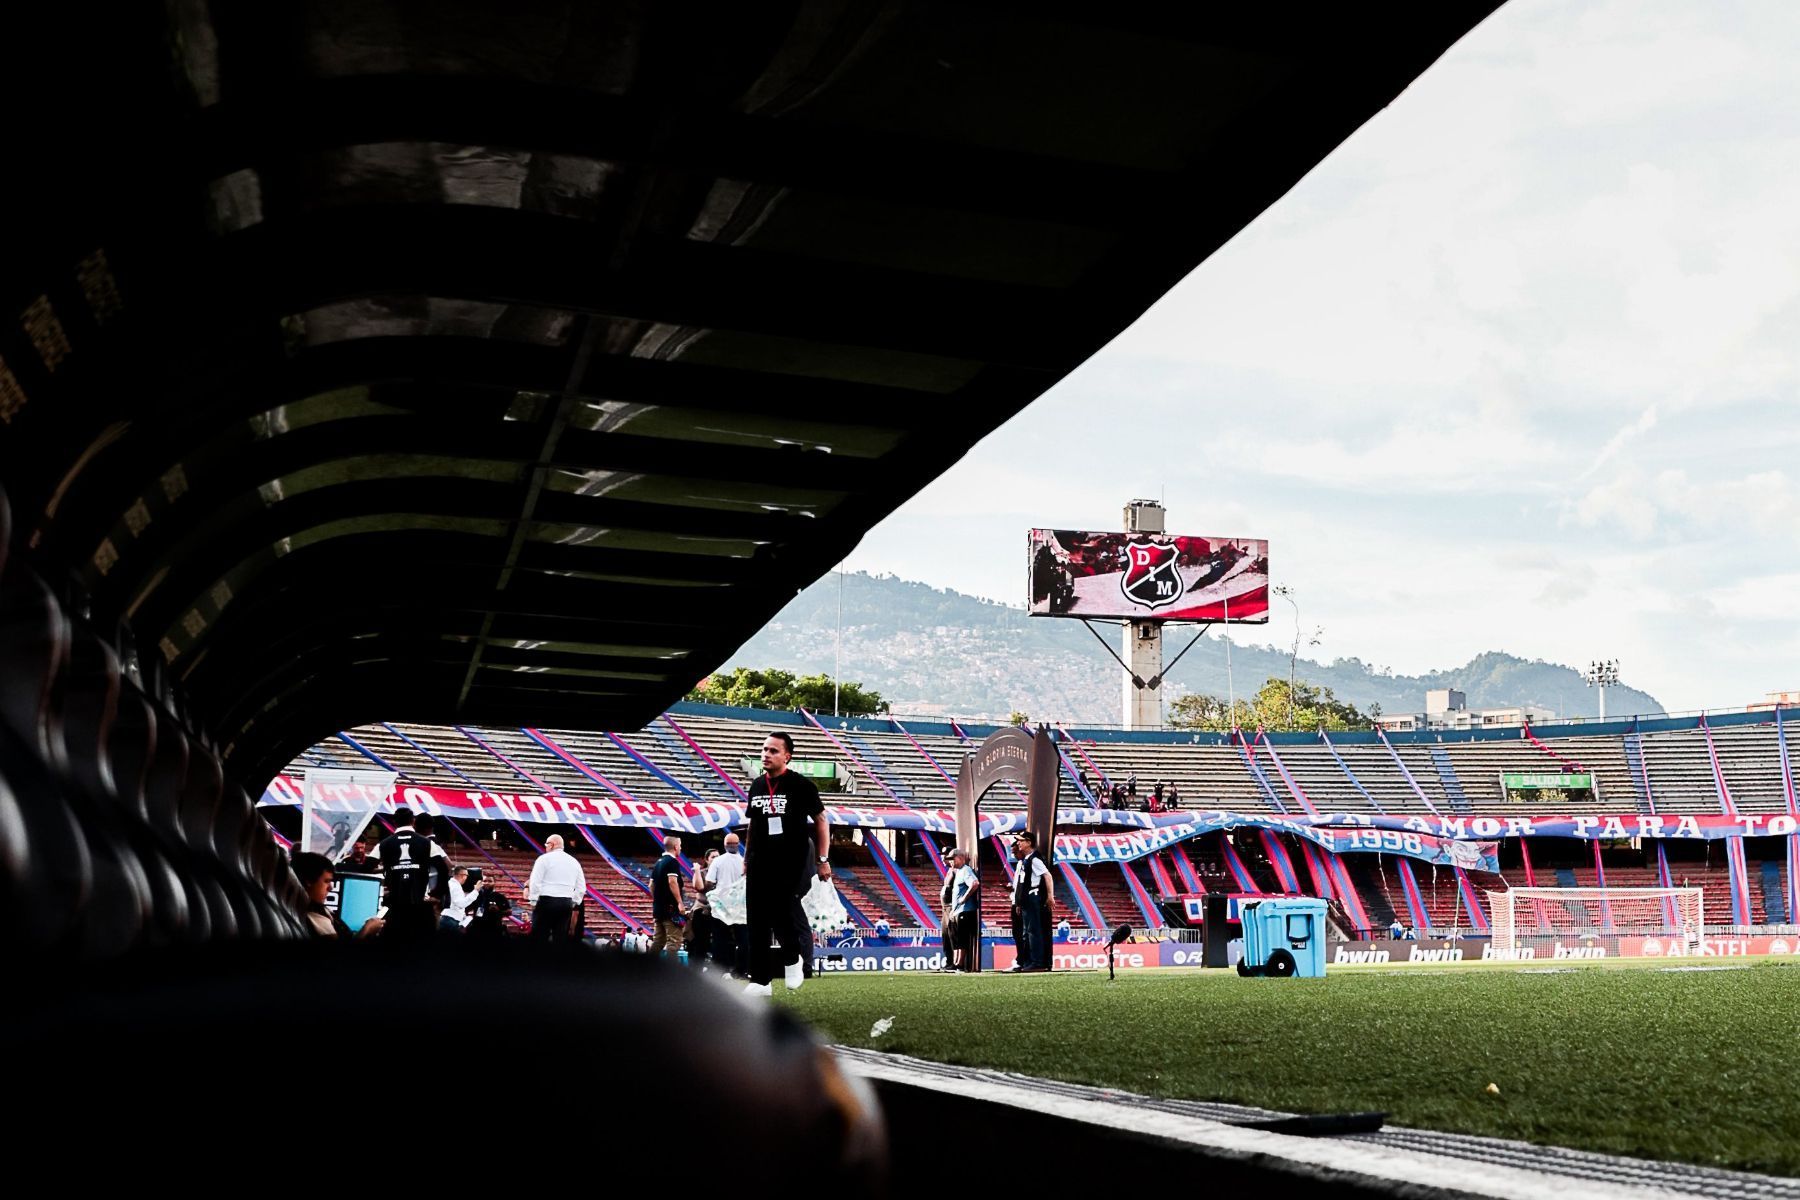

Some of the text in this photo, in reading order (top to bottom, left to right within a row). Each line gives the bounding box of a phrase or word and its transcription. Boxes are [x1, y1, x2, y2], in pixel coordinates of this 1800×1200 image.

[986, 746, 1005, 766] GLORIA
[1007, 745, 1027, 763] ETERNA
[1523, 775, 1560, 785] SALIDA
[751, 798, 787, 808] POWER
[1404, 816, 1537, 839] AMOR
[1572, 816, 1704, 839] PARA
[1347, 830, 1422, 853] 1998
[1053, 949, 1144, 970] mapfre
[1334, 943, 1390, 963] bwin
[1409, 942, 1464, 962] bwin
[1482, 941, 1534, 961] bwin
[1553, 940, 1606, 959] bwin
[812, 955, 848, 971] ree
[852, 956, 878, 971] en
